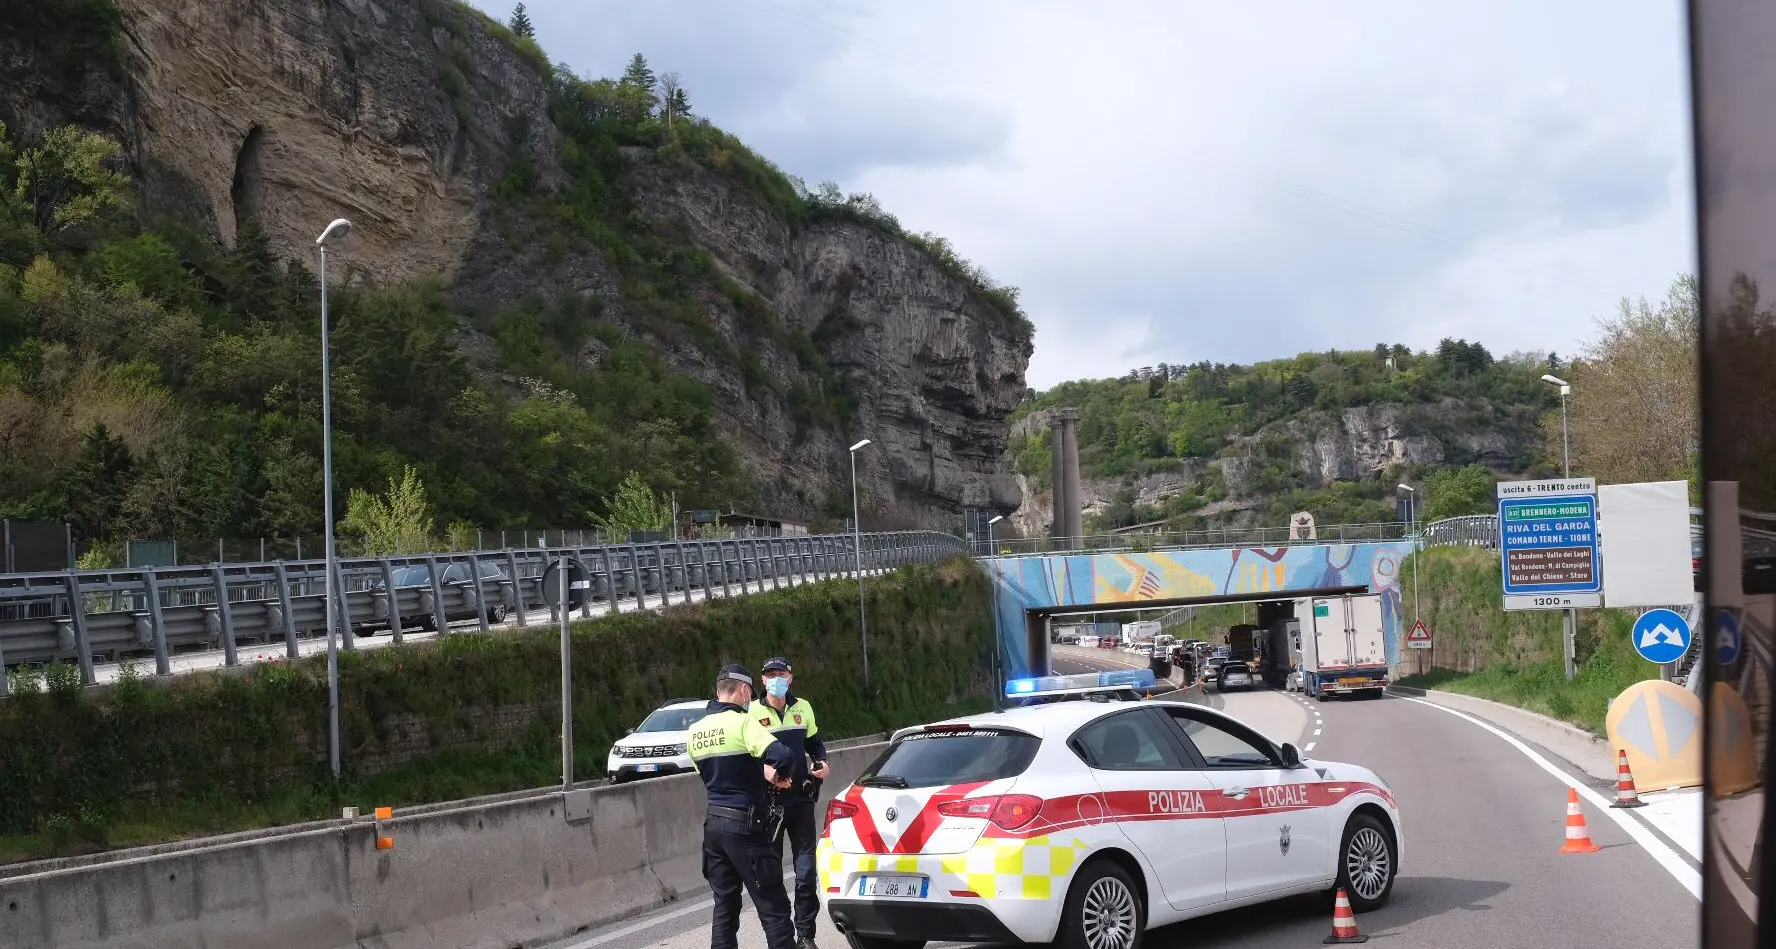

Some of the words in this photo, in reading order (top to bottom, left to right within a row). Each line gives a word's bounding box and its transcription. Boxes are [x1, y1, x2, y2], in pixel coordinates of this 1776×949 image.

[1537, 483, 1565, 492] TRENTO
[1521, 507, 1587, 516] BRENNERO-MODENA
[1507, 524, 1529, 533] RIVA
[1533, 523, 1552, 532] DEL
[1555, 521, 1590, 531] GARDA
[1508, 536, 1537, 544] COMANO
[1539, 535, 1563, 543] TERME
[1561, 561, 1590, 569] Campiglio
[1570, 570, 1588, 579] Storo
[693, 728, 724, 741] POLIZIA
[693, 737, 725, 750] LOCALE
[1148, 791, 1206, 813] POLIZIA
[1258, 784, 1309, 808] LOCALE
[885, 883, 899, 895] 488
[907, 884, 918, 896] AN
